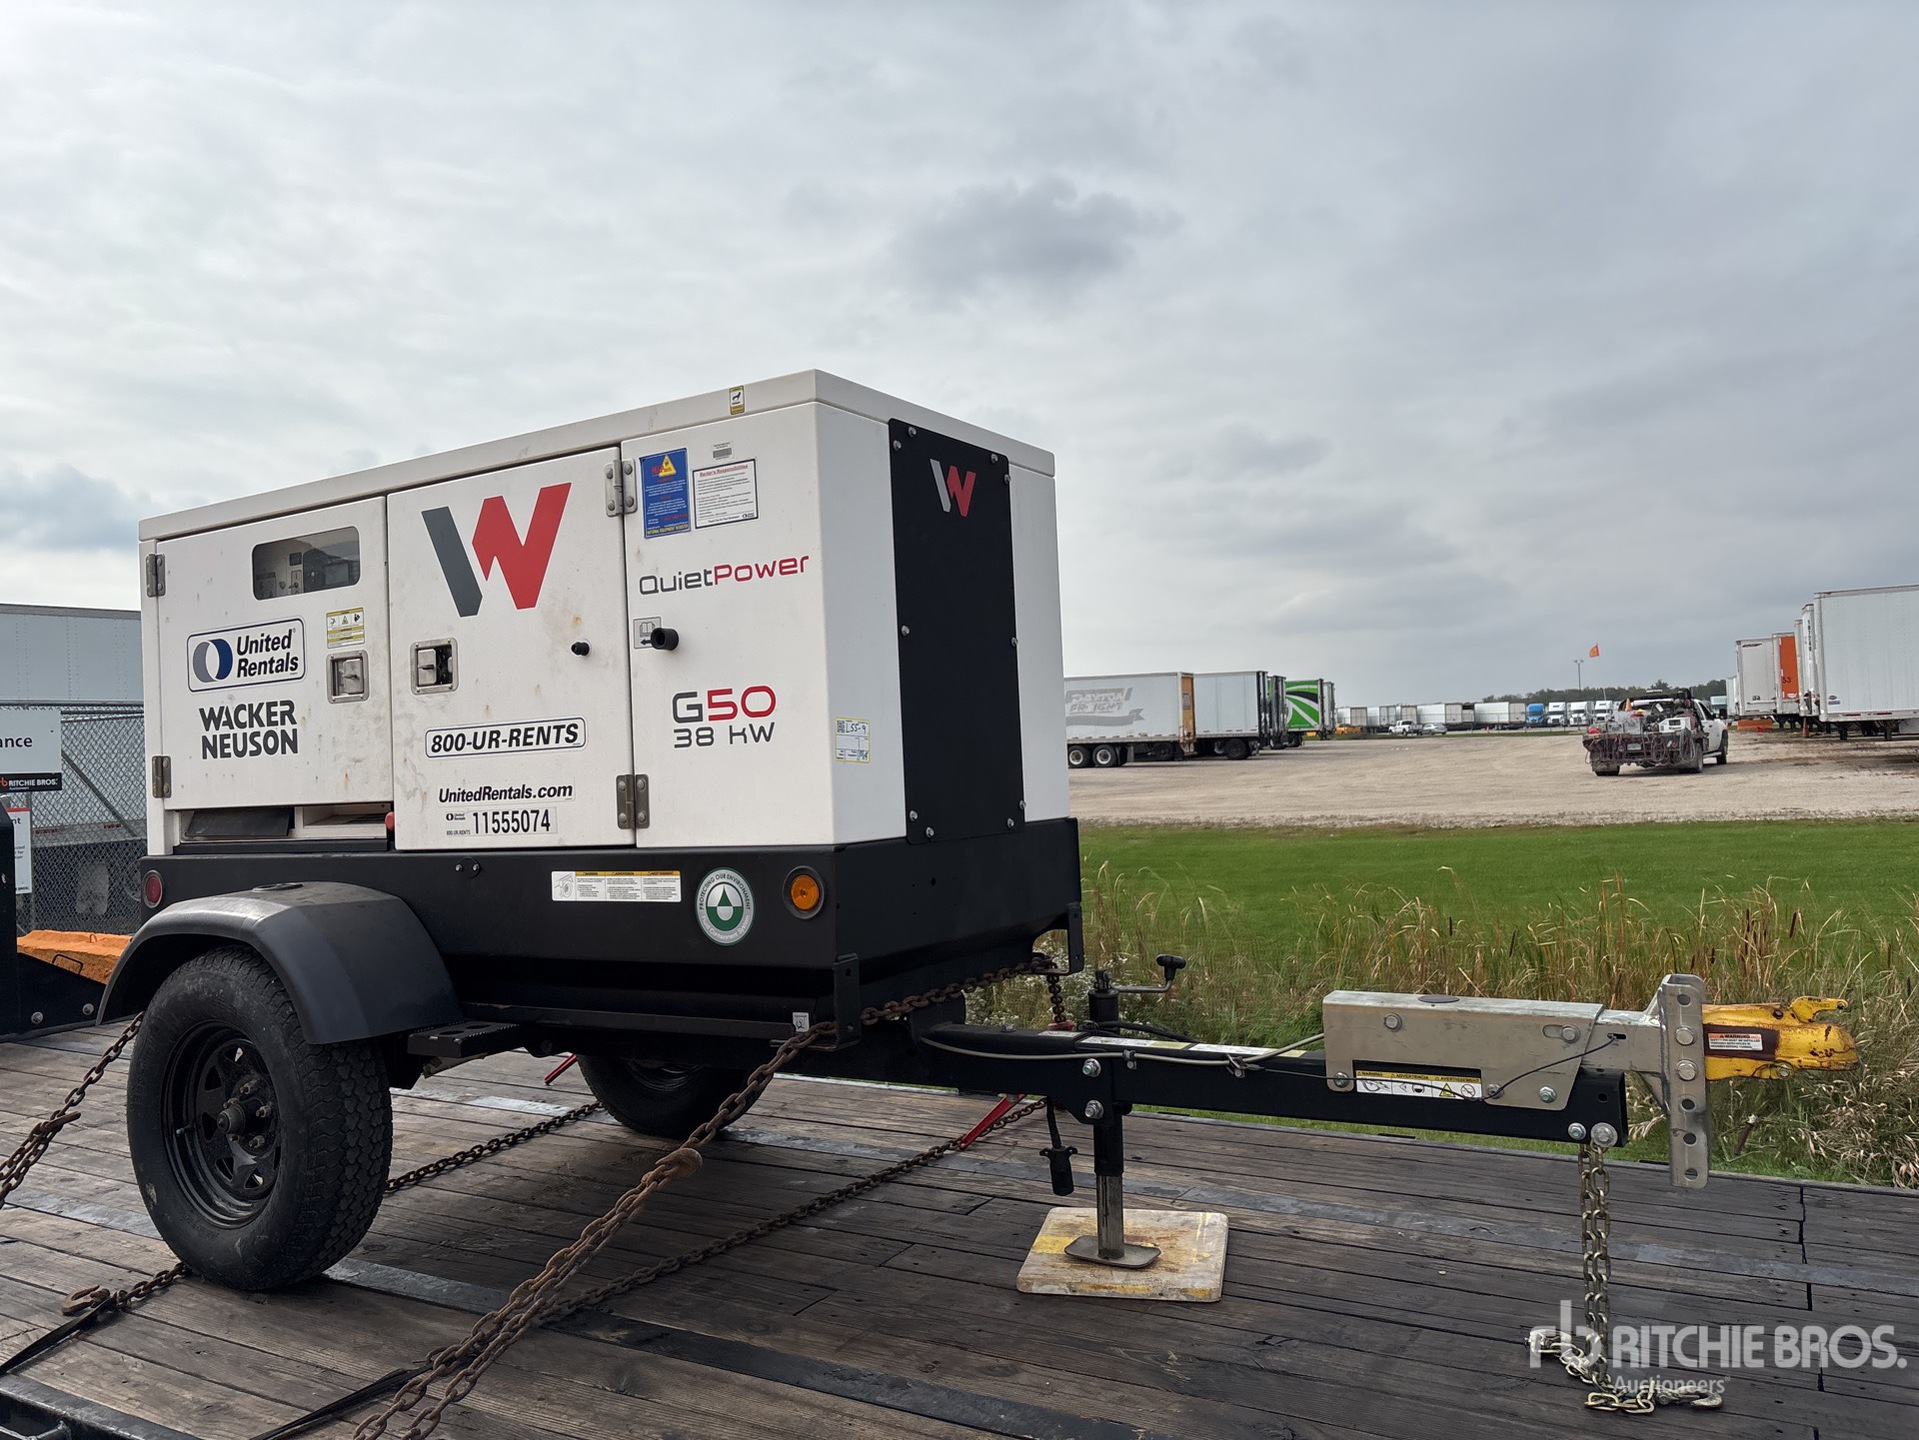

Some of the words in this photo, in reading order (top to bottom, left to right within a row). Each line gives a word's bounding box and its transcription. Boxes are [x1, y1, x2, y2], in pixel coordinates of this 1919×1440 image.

[639, 556, 809, 595] QuietPower
[237, 628, 293, 656] United
[237, 652, 299, 678] Rentals
[199, 700, 297, 732] WACKER
[672, 685, 776, 723] G50
[202, 728, 298, 760] NEUSON
[431, 723, 578, 753] 800-UR-RENTS
[673, 727, 715, 748] 38
[8, 779, 36, 787] RITCHIE
[438, 784, 573, 803] UnitedRentals.com
[473, 809, 550, 834] 11555074
